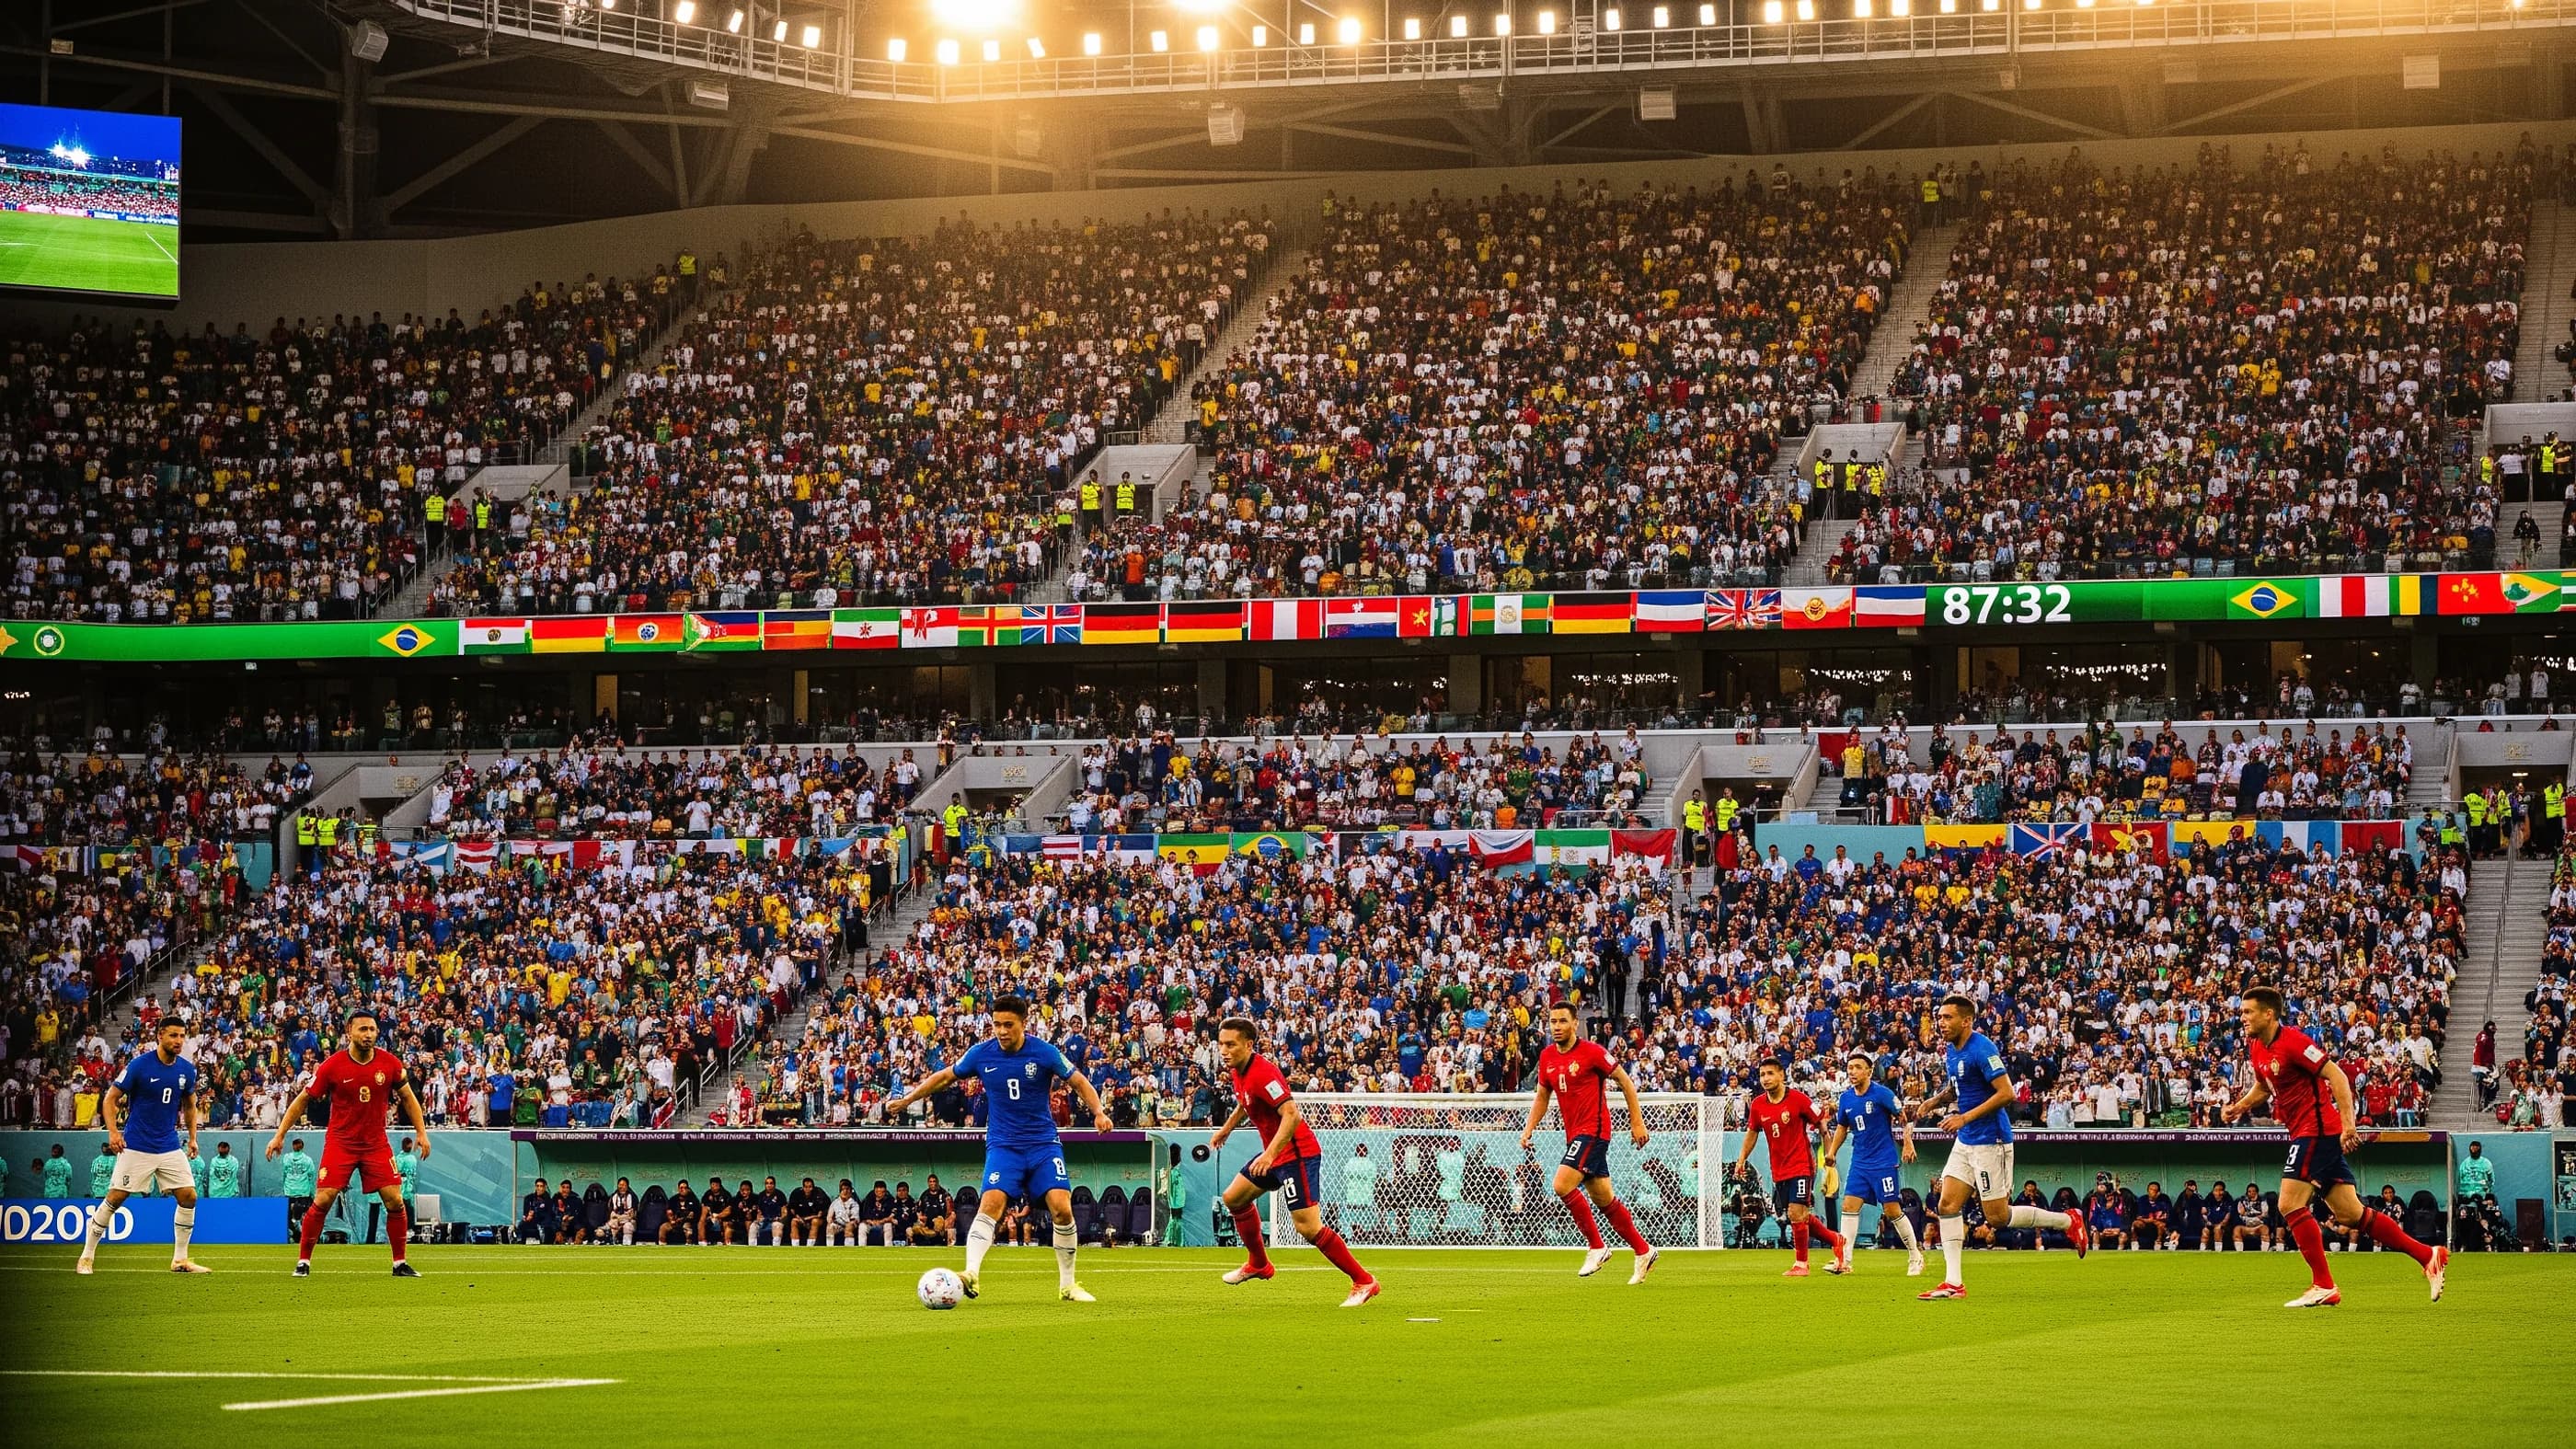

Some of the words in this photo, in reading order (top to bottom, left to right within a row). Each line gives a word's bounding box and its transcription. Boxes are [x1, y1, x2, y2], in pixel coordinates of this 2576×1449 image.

[1943, 584, 2071, 625] 87:32
[162, 1087, 172, 1104] 8
[360, 1086, 371, 1102] 8
[0, 1204, 134, 1241] D20D
